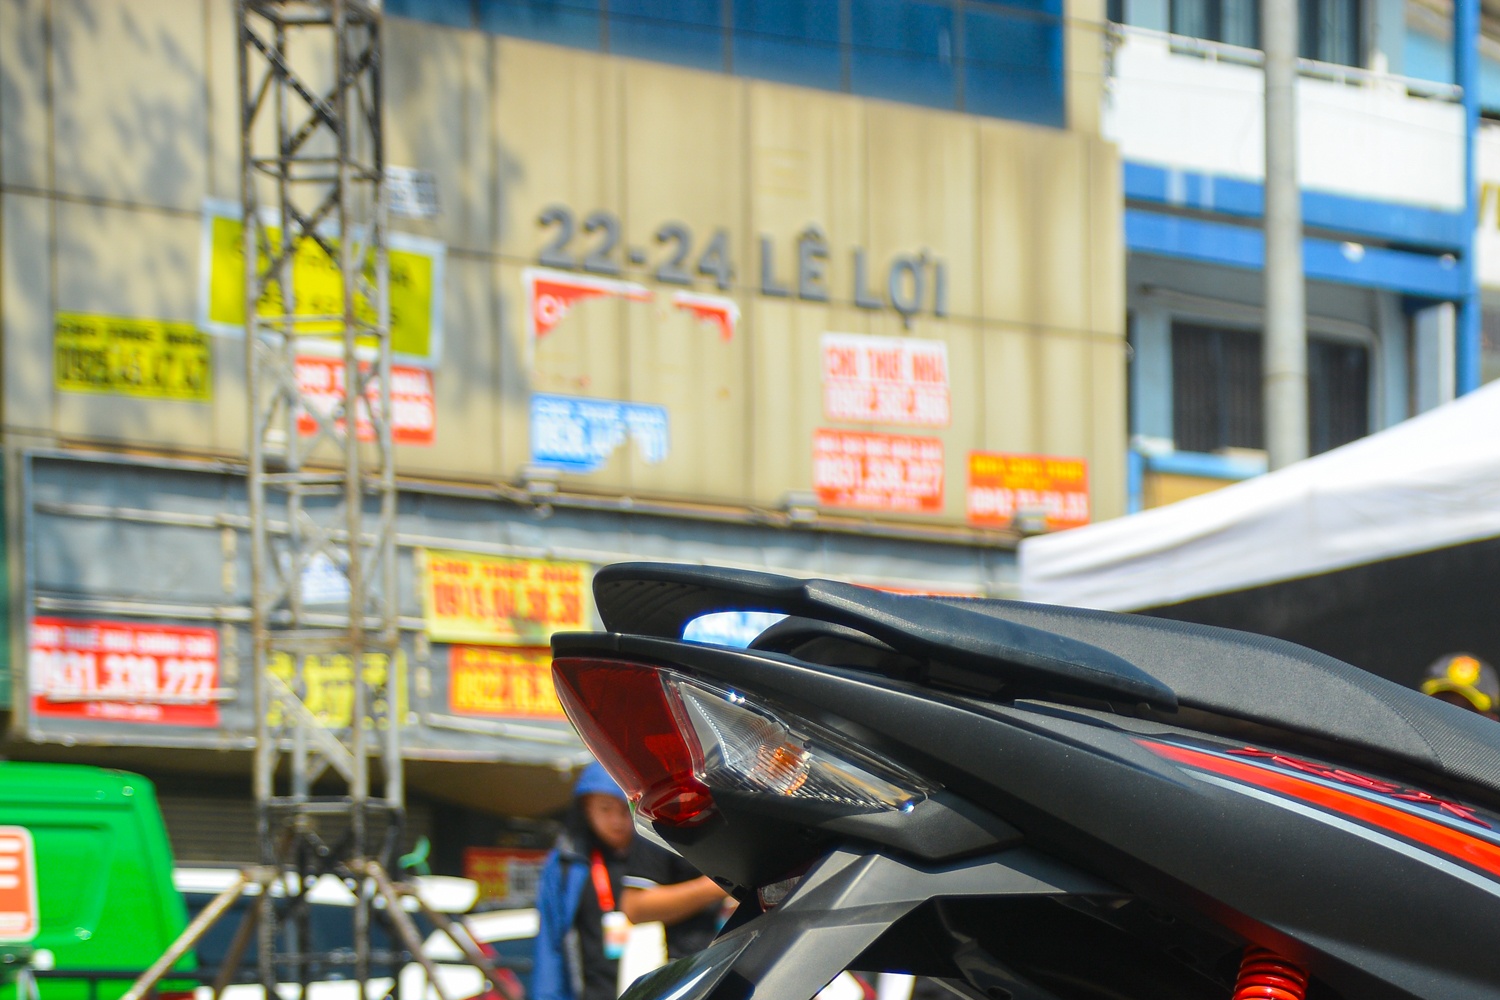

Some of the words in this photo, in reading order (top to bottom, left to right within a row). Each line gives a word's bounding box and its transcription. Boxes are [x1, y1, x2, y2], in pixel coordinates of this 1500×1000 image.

[536, 205, 735, 290] 22-24
[757, 224, 831, 302] LÊ
[852, 243, 950, 328] LỢI
